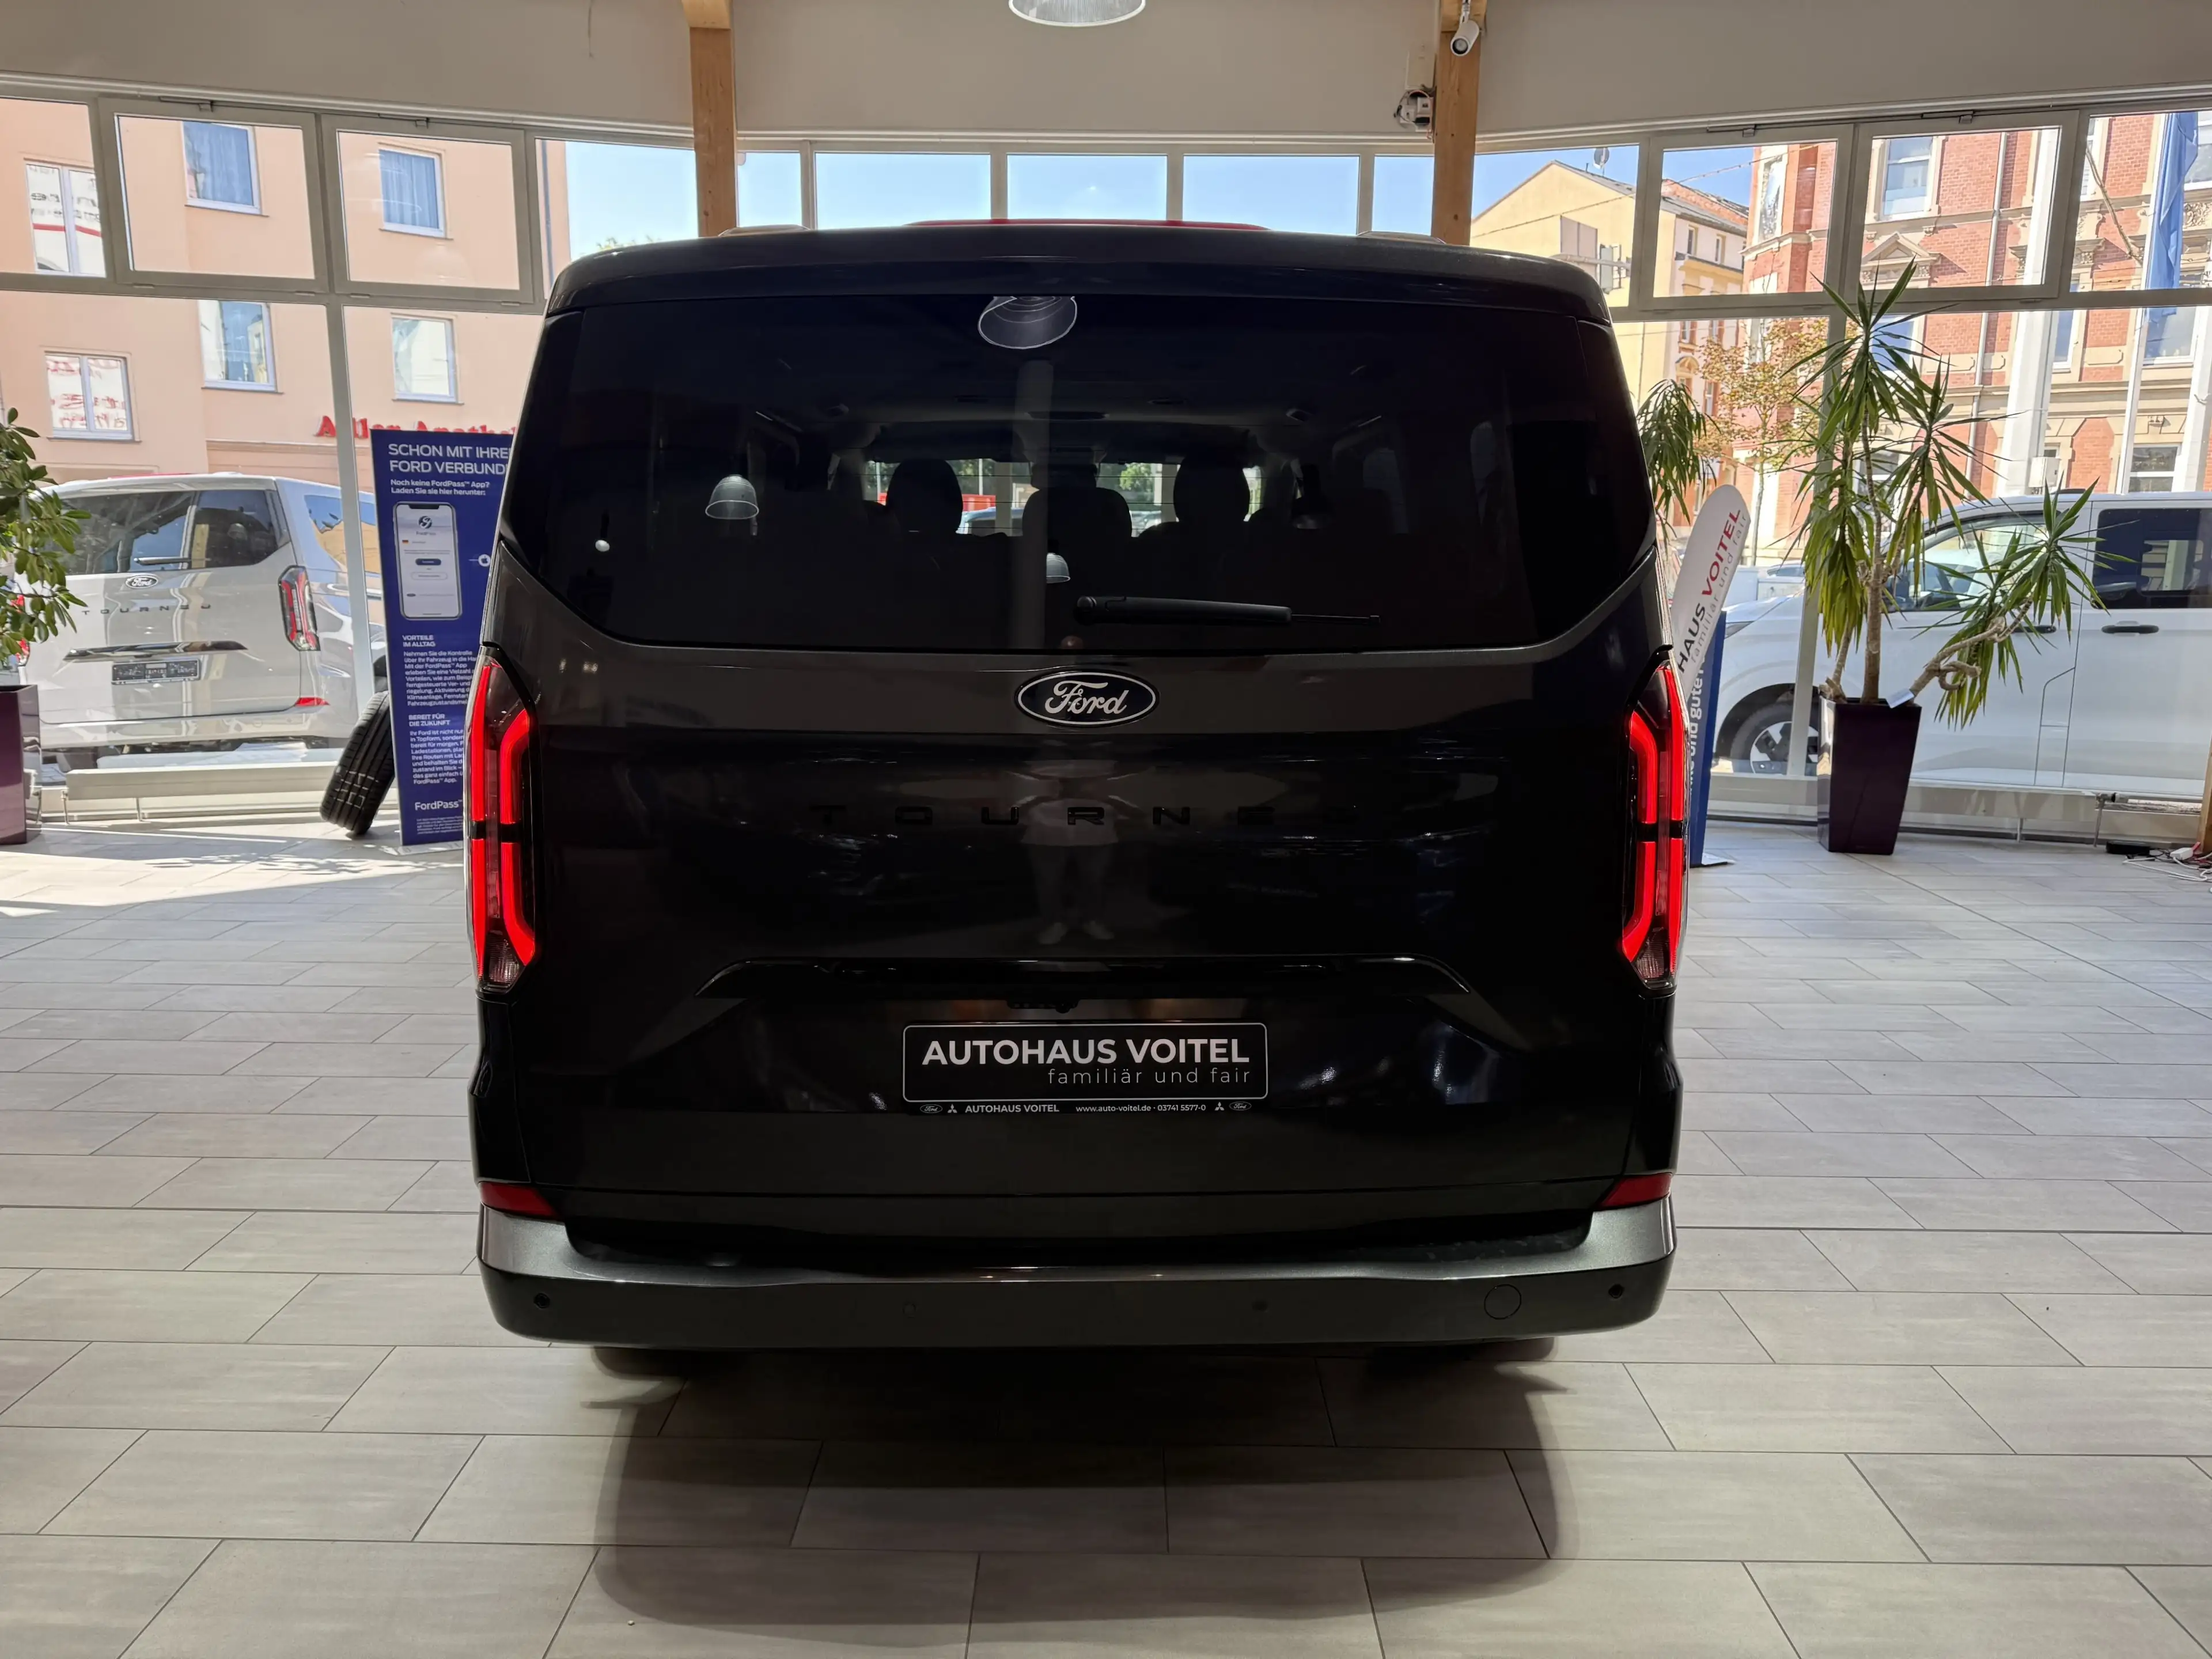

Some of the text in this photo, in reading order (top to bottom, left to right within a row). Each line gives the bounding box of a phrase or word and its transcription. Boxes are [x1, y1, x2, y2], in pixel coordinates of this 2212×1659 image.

[388, 444, 510, 459] SCHON MIT IHRE
[389, 460, 508, 475] FORD VERBUND
[1702, 510, 1741, 596] VOITEL
[1719, 552, 1733, 588] und
[1732, 516, 1747, 545] fair
[1045, 680, 1128, 717] Ford
[922, 1038, 1250, 1065] AUTOHAUS VOITEL
[1048, 1067, 1250, 1084] familiär und fair
[965, 1104, 1021, 1113] AUTOHAUS
[1024, 1104, 1059, 1112] VOITEL
[1075, 1104, 1151, 1112] www.auto-voitel.de
